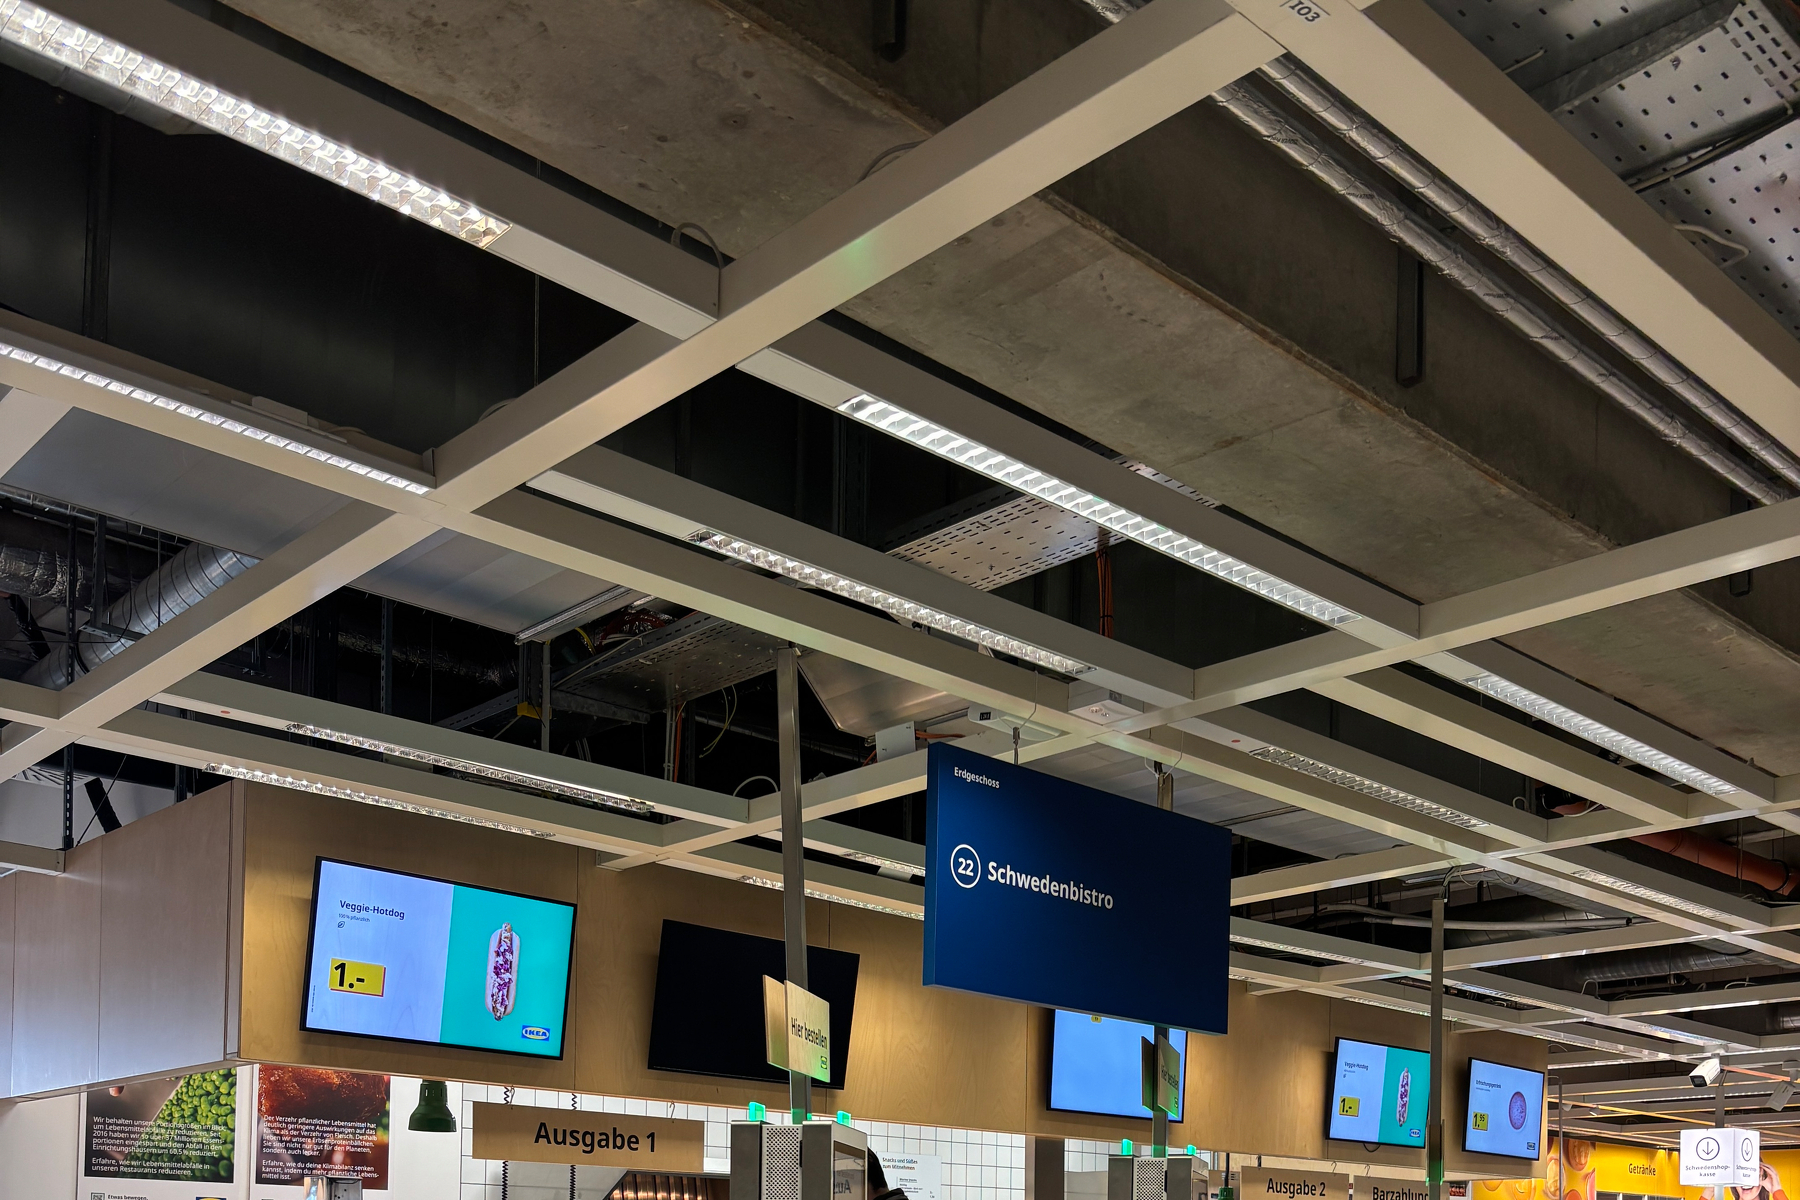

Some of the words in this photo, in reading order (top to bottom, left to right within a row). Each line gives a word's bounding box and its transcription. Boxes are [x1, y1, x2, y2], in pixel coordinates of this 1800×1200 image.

[954, 767, 1000, 789] Erdgeschoss
[957, 858, 974, 877] 22
[987, 861, 1114, 910] Schwedenbistro
[339, 899, 405, 920] Veggie-Hotdog
[334, 962, 365, 989] 1.-
[524, 1029, 548, 1038] IKEA
[791, 1017, 804, 1038] Hier
[804, 1022, 827, 1049] bestellen
[534, 1122, 640, 1155] Ausgabe
[646, 1131, 656, 1153] 1
[1629, 1163, 1656, 1176] Getränke
[1266, 1178, 1317, 1199] Ausgabe
[1319, 1182, 1326, 1196] 2
